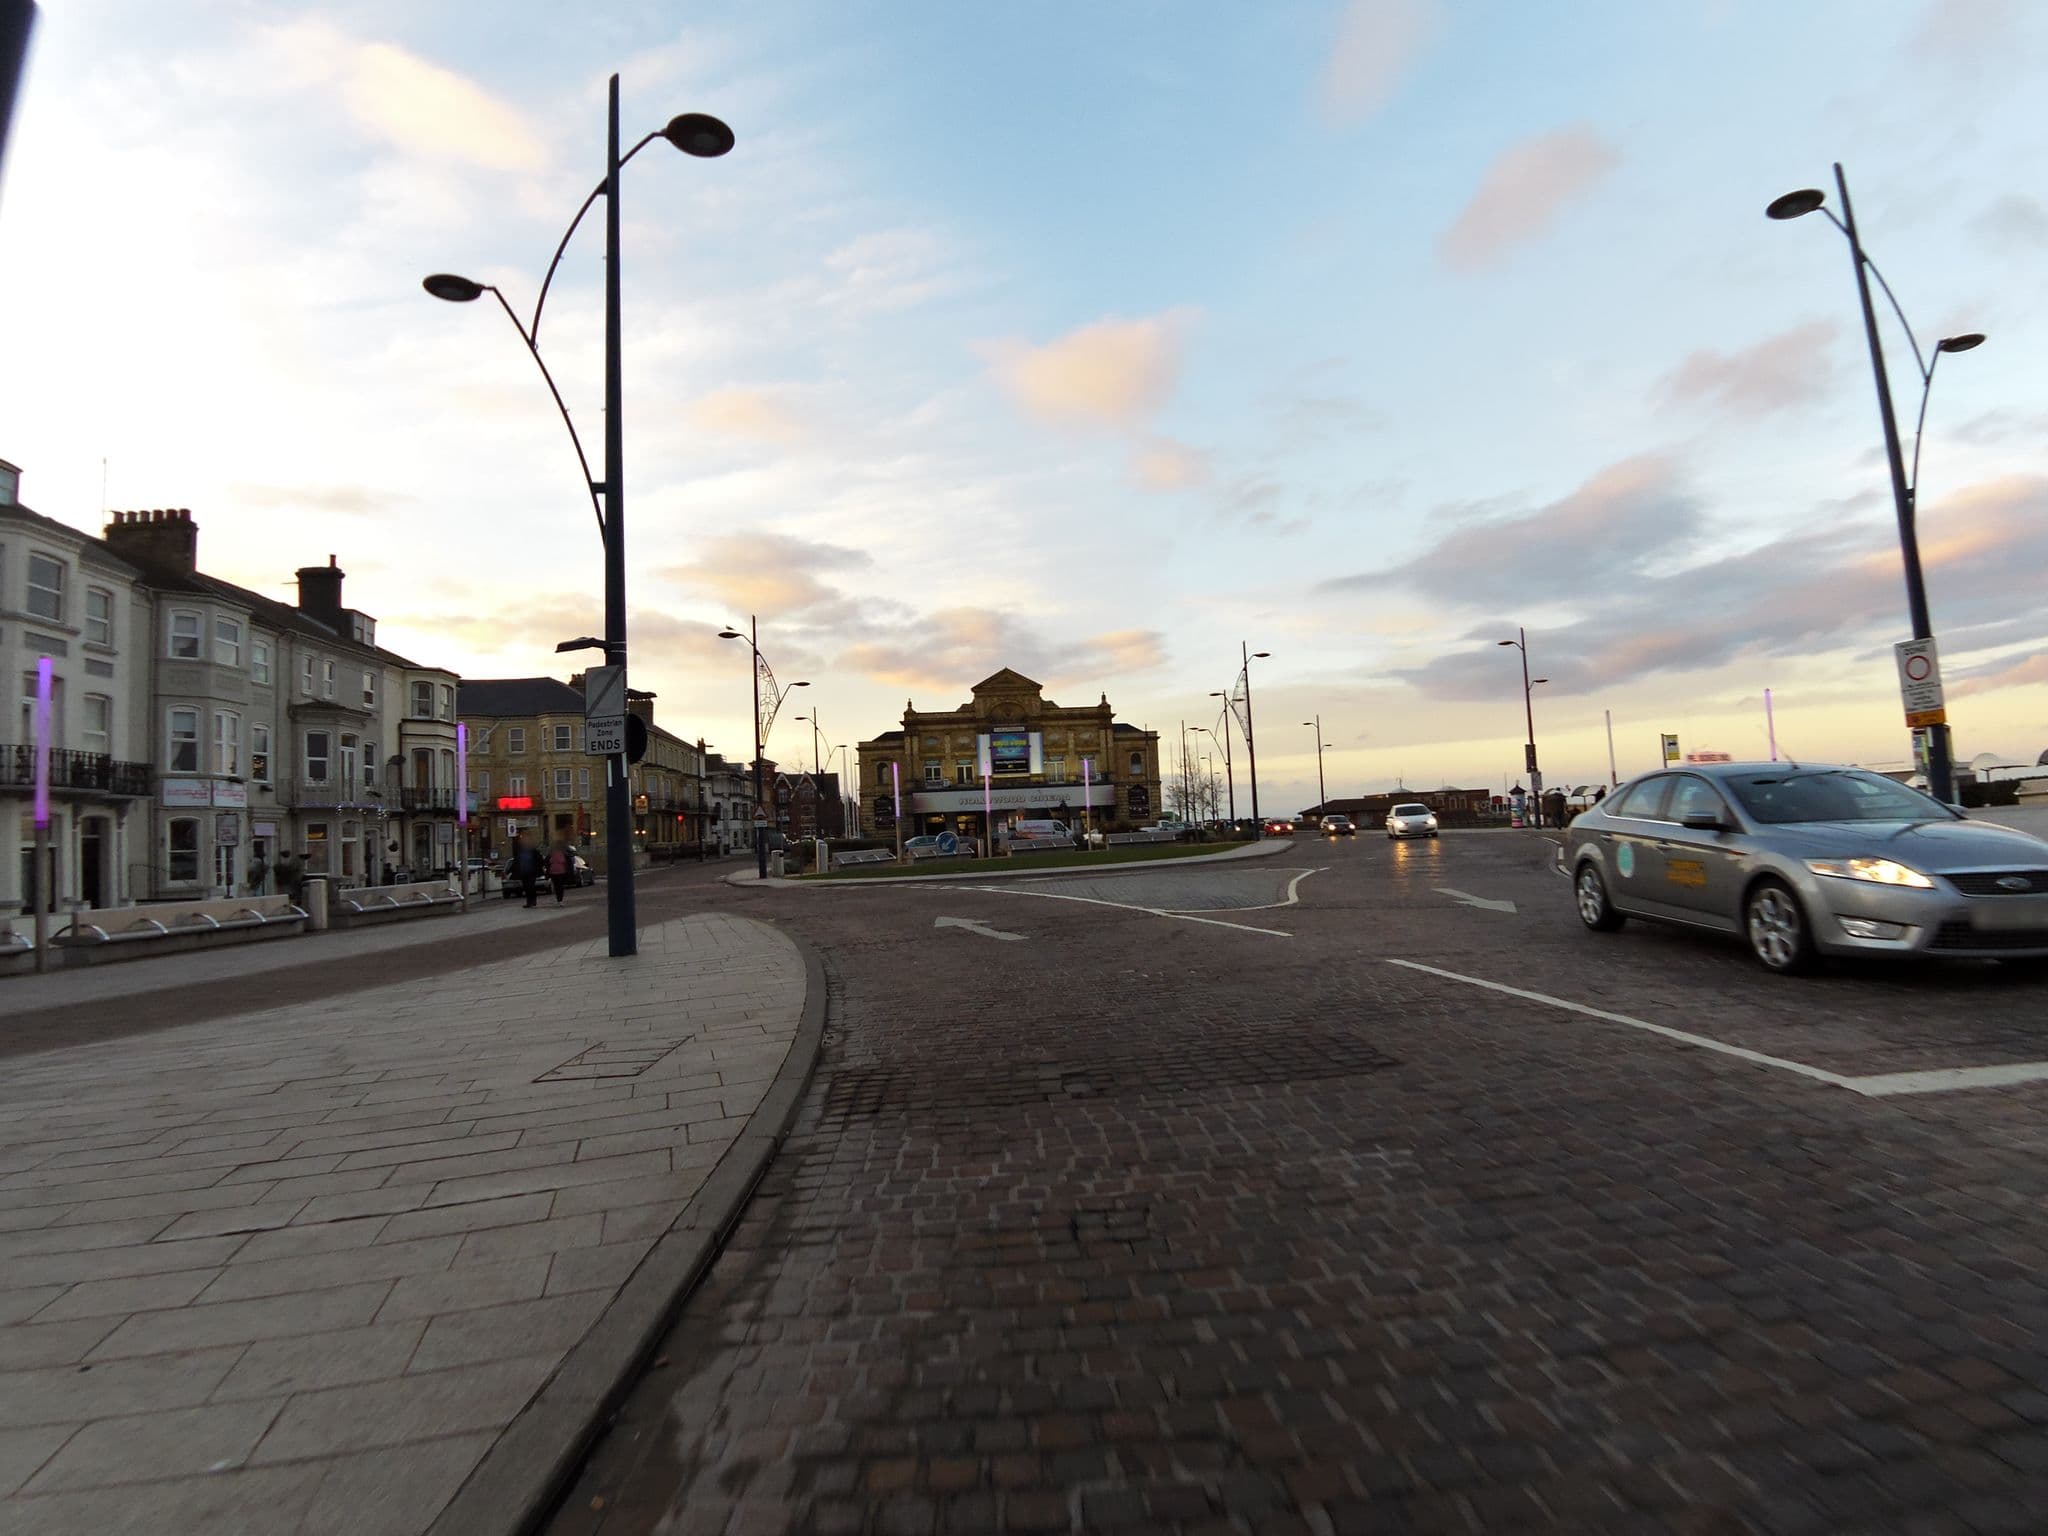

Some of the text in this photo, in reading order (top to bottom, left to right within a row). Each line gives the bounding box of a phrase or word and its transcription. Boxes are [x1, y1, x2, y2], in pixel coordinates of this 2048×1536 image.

[588, 720, 623, 729] Pedestrian
[597, 729, 614, 737] Zone
[590, 739, 621, 751] ENDS
